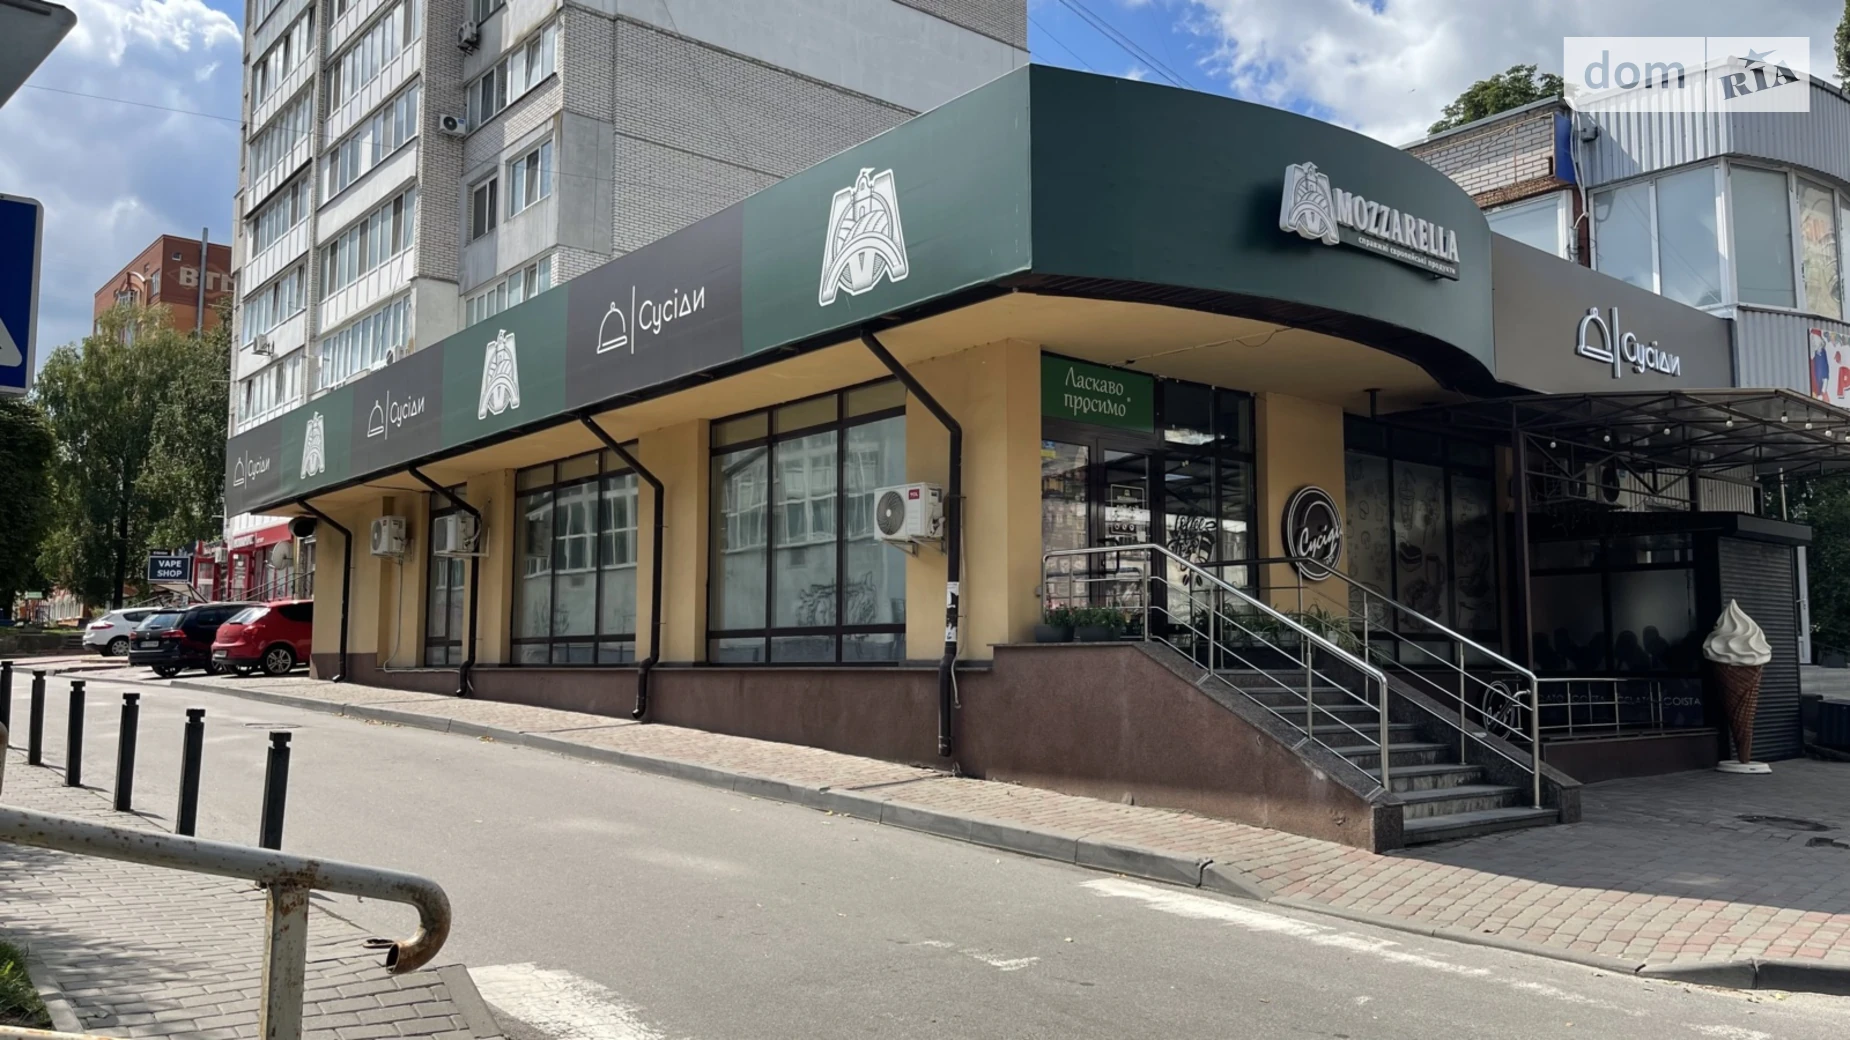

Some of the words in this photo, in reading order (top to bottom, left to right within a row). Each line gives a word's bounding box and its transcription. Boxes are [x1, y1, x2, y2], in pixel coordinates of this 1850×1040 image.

[1332, 187, 1460, 263] MOZZARELLA
[639, 286, 705, 335] Сусіди
[1620, 331, 1681, 377] Сусіди
[1065, 366, 1125, 396] Ласкаво
[389, 395, 425, 428] Сусіди
[1064, 393, 1127, 417] просимо
[248, 456, 271, 480] Сусіди
[157, 569, 183, 578] SHOP
[158, 560, 182, 568] VAPE
